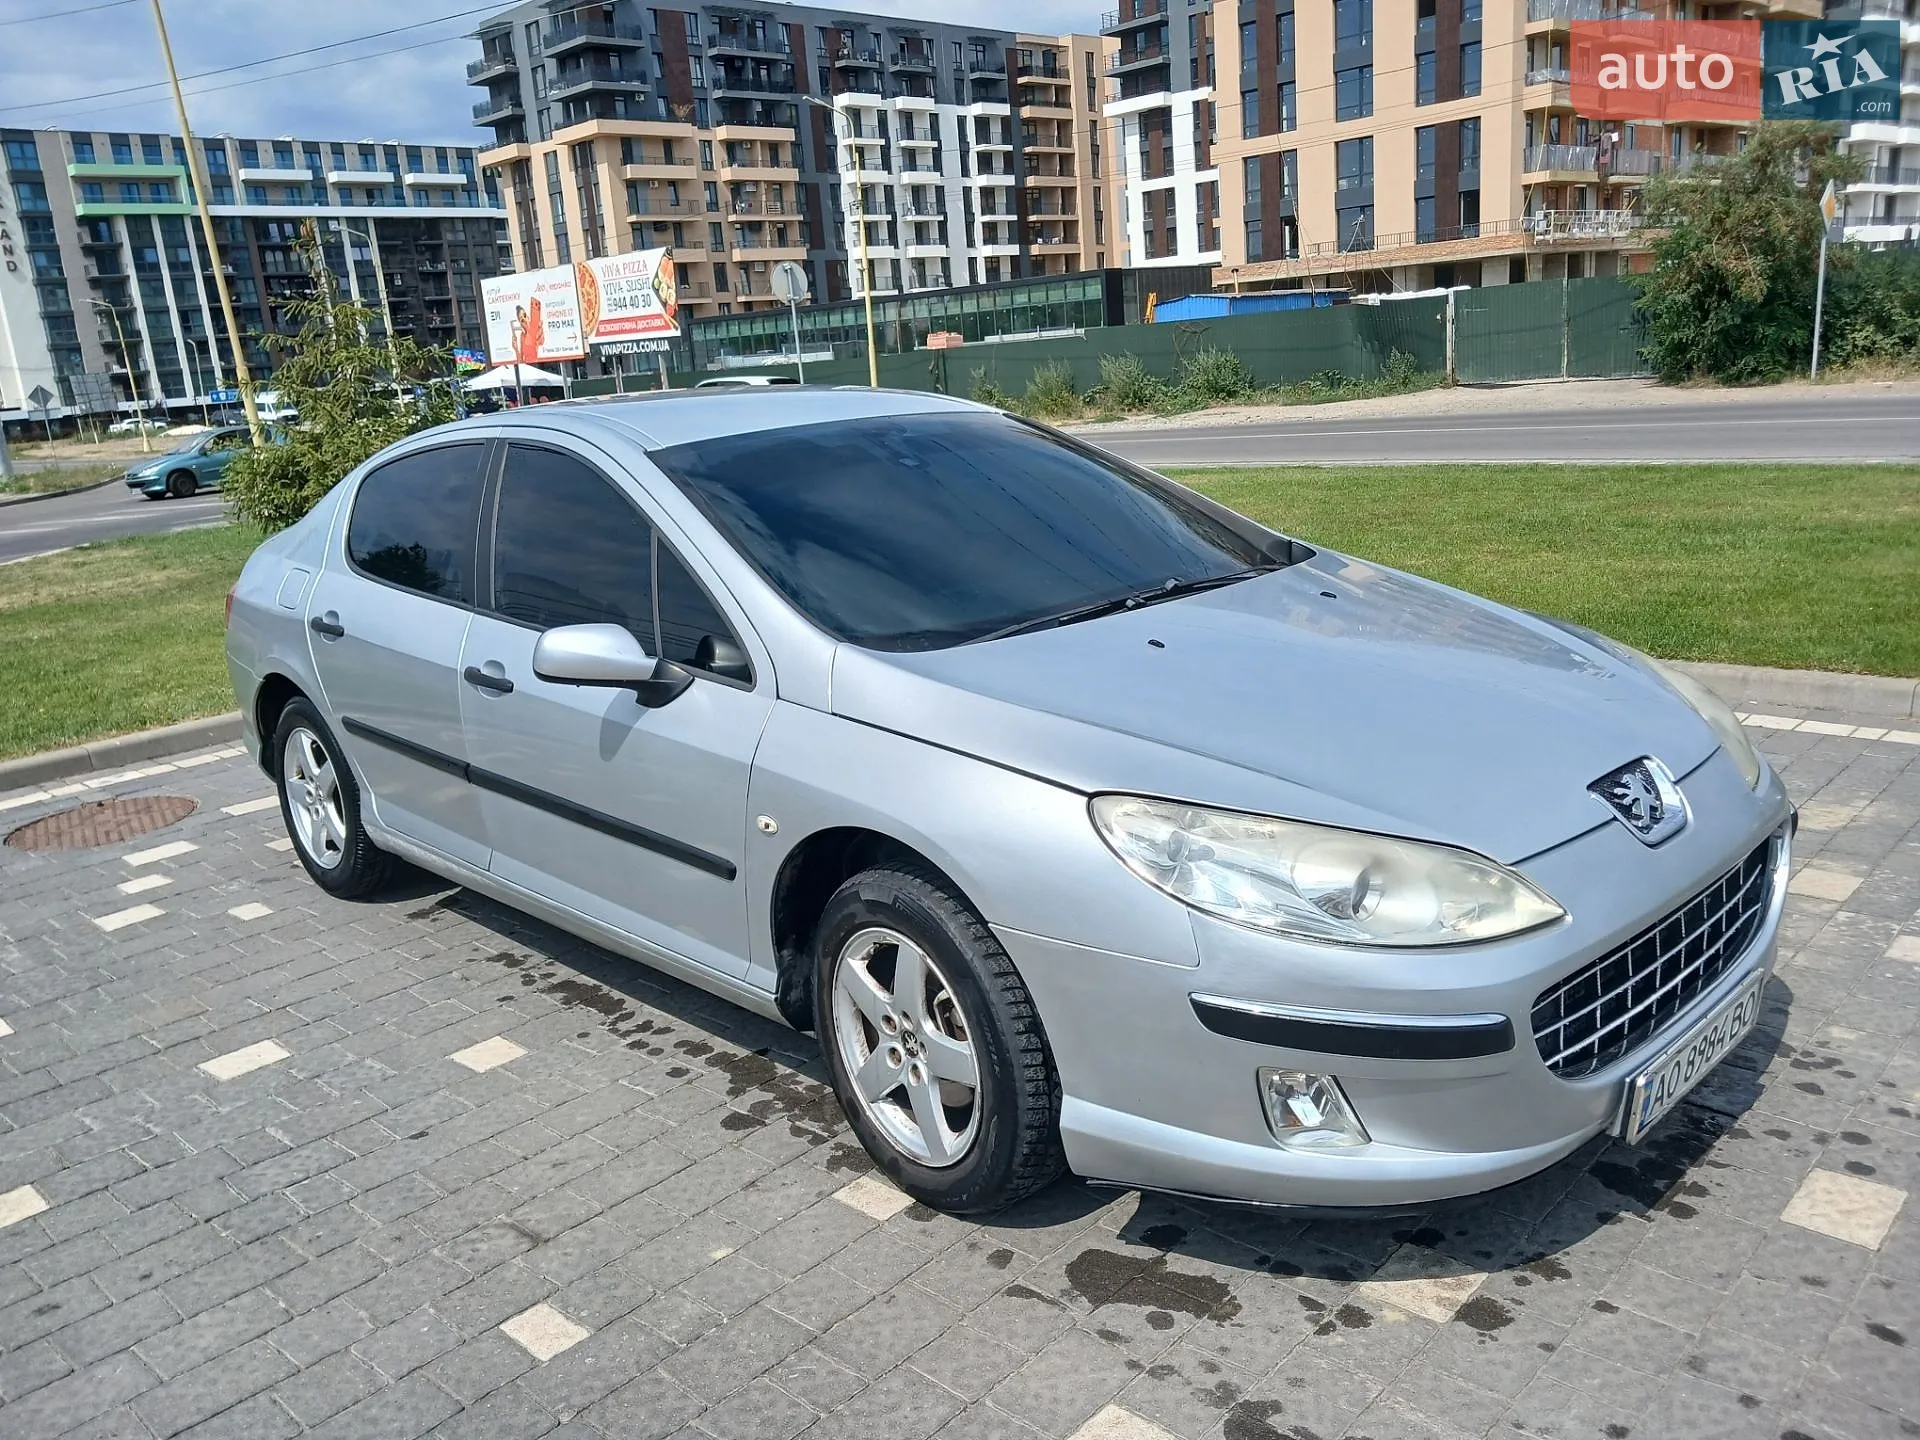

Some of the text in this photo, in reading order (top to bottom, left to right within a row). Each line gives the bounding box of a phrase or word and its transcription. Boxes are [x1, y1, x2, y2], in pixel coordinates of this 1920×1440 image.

[601, 259, 648, 278] VIVA PIZZA
[603, 276, 651, 295] VIVA SUSHI
[613, 296, 628, 312] 944
[630, 294, 640, 310] 40
[641, 293, 652, 308] 30
[548, 319, 575, 329] PRO MAX
[637, 318, 666, 330] ДОСТАВКА
[600, 339, 670, 355] VIVAPIZZA.COM.UA
[1649, 990, 1755, 1116] AO 8984 BO
